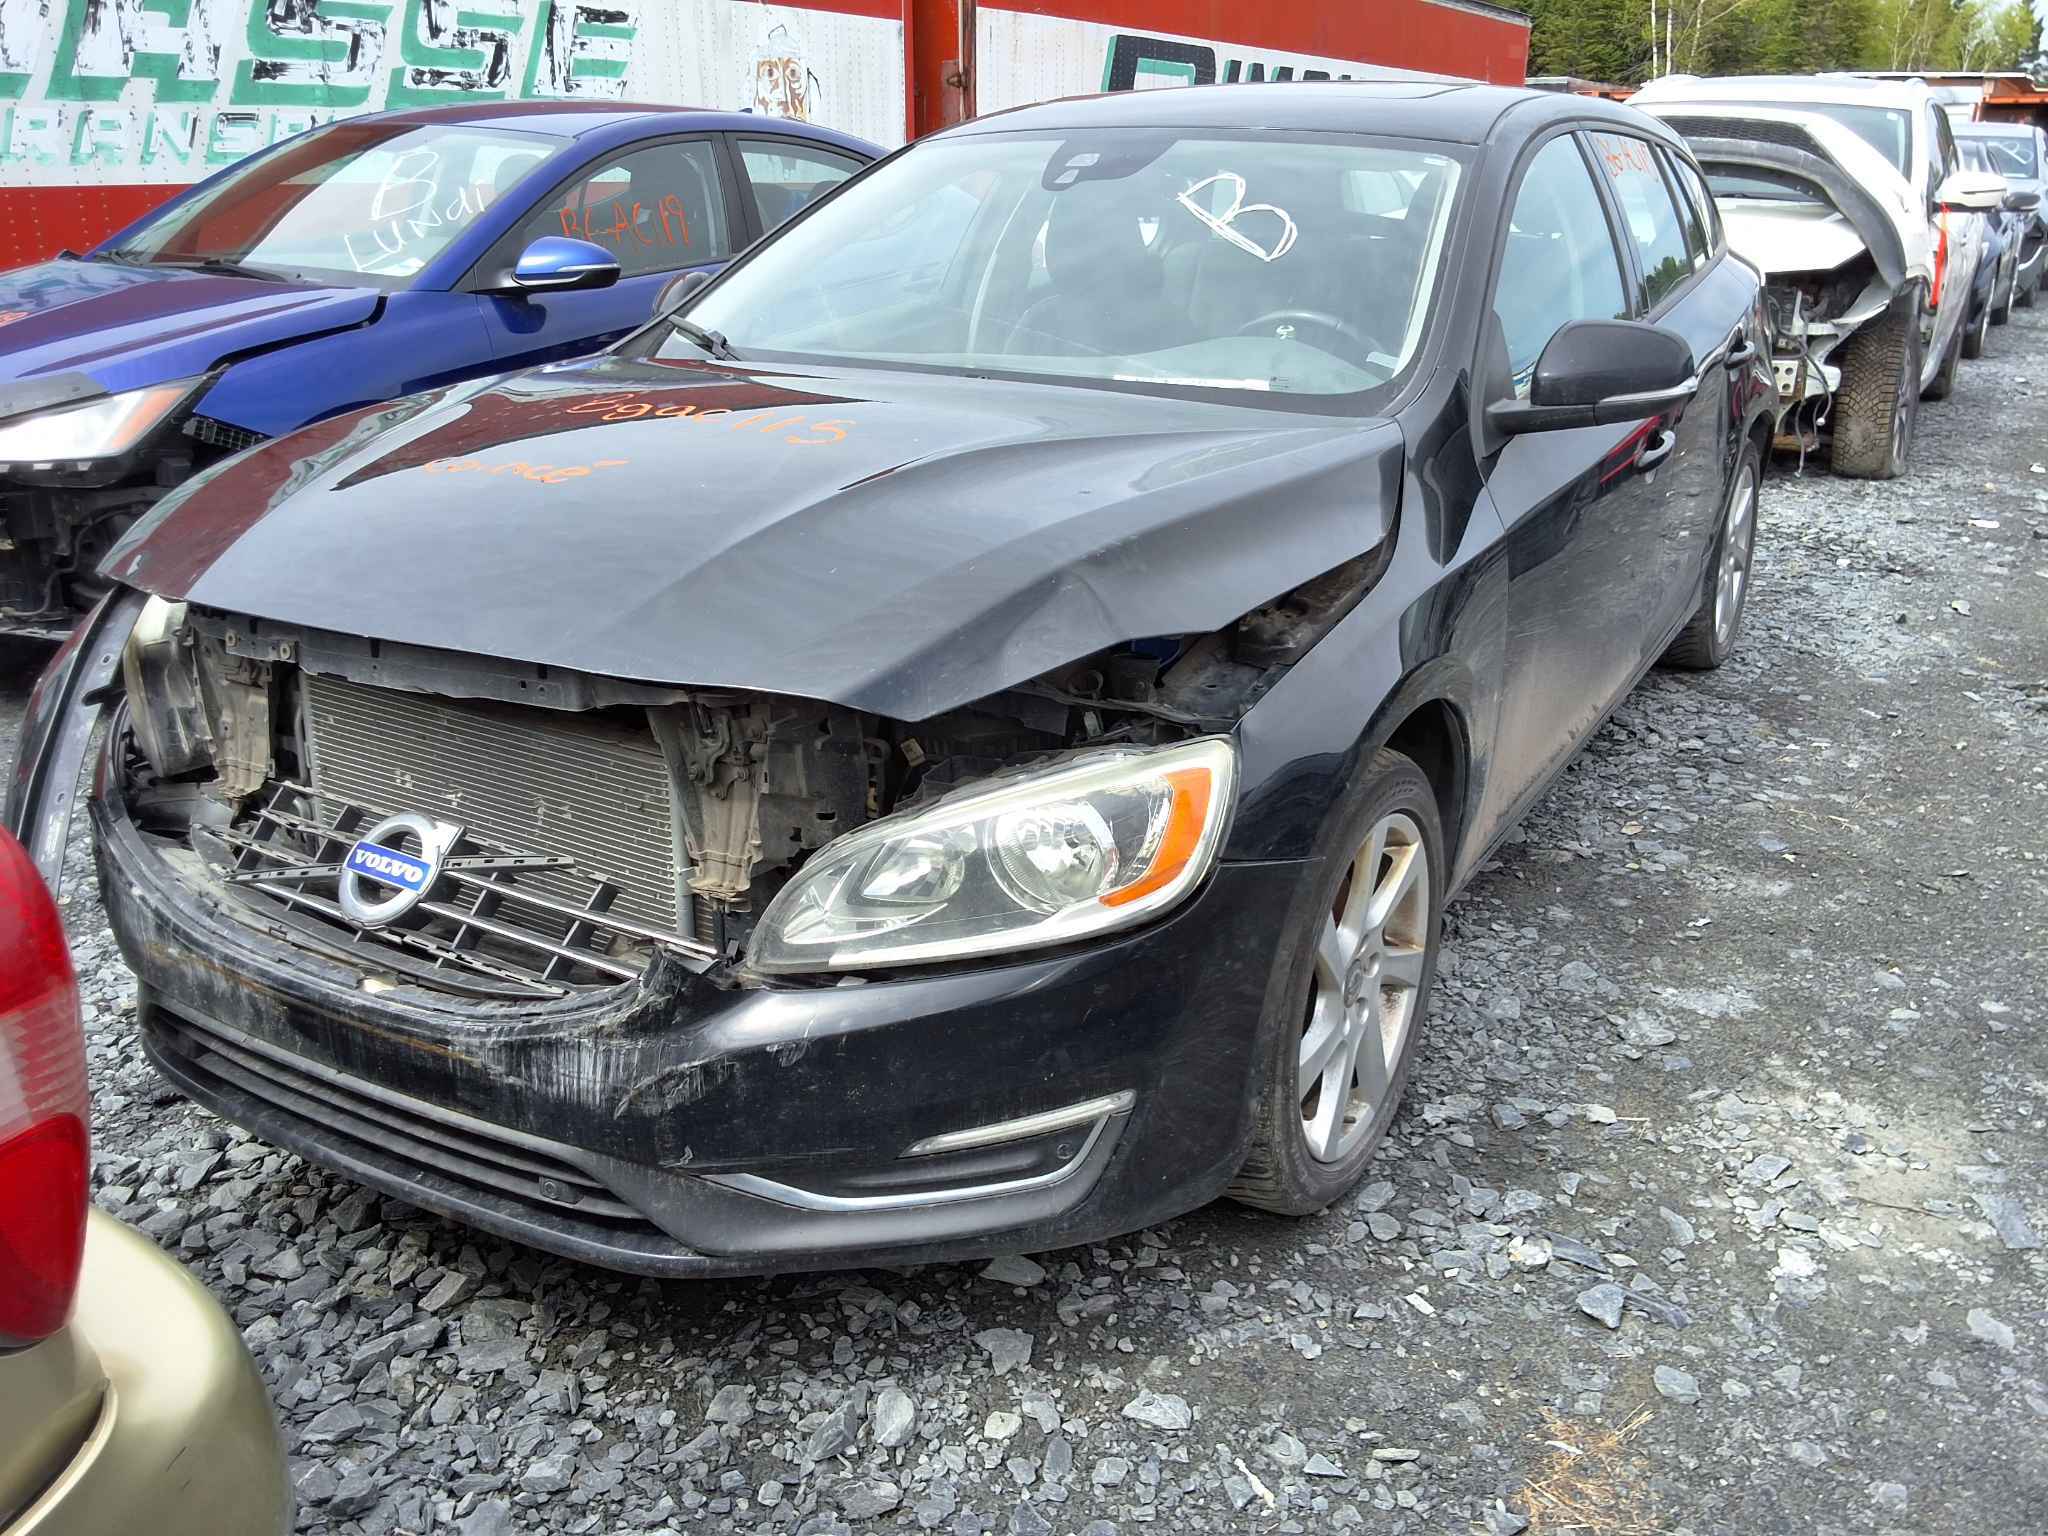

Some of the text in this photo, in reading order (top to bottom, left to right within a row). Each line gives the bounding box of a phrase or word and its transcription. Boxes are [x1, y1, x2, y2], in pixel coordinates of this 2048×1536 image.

[370, 150, 440, 221] B
[1175, 172, 1298, 262] B
[353, 848, 424, 883] VOLVO
